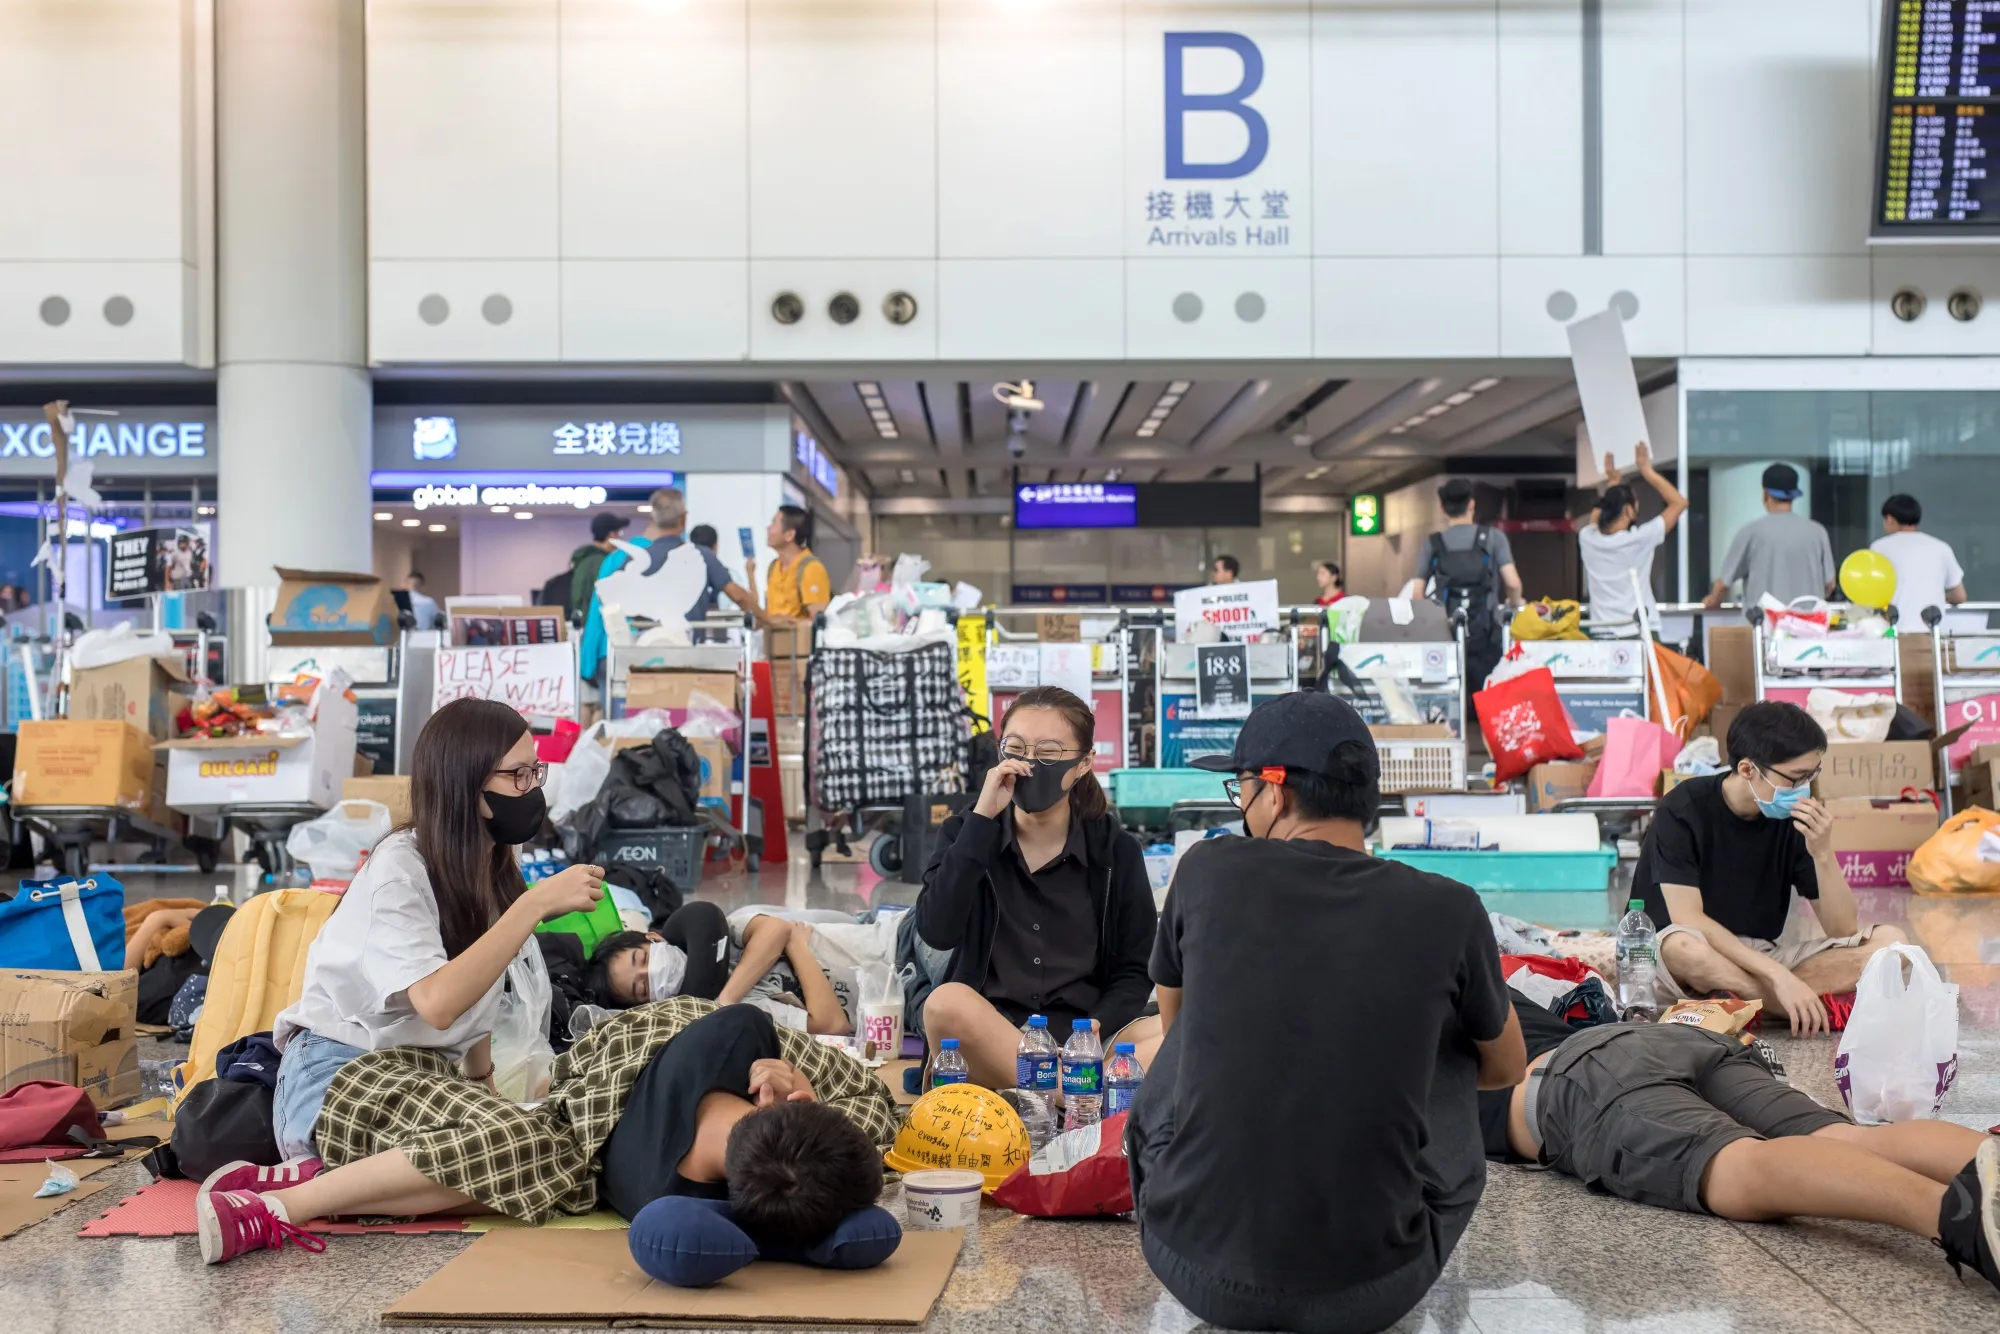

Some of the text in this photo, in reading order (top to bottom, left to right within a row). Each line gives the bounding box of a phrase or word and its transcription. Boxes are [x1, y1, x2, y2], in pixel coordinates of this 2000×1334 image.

[1164, 31, 1269, 180] B
[1146, 190, 1290, 221] 接機大堂
[1148, 226, 1290, 246] Arrivals Hall
[0, 422, 206, 457] XCHANGE
[413, 483, 607, 510] global exchange
[115, 537, 149, 557] THEY
[1216, 593, 1248, 604] POLICE
[1202, 607, 1249, 624] SHOOT
[438, 648, 530, 684] PLEASE
[506, 675, 564, 703] WITH
[358, 714, 391, 725] rokers
[199, 751, 279, 778] BULGARI
[1833, 752, 1918, 780] 日用品
[934, 1101, 962, 1117] Smoke
